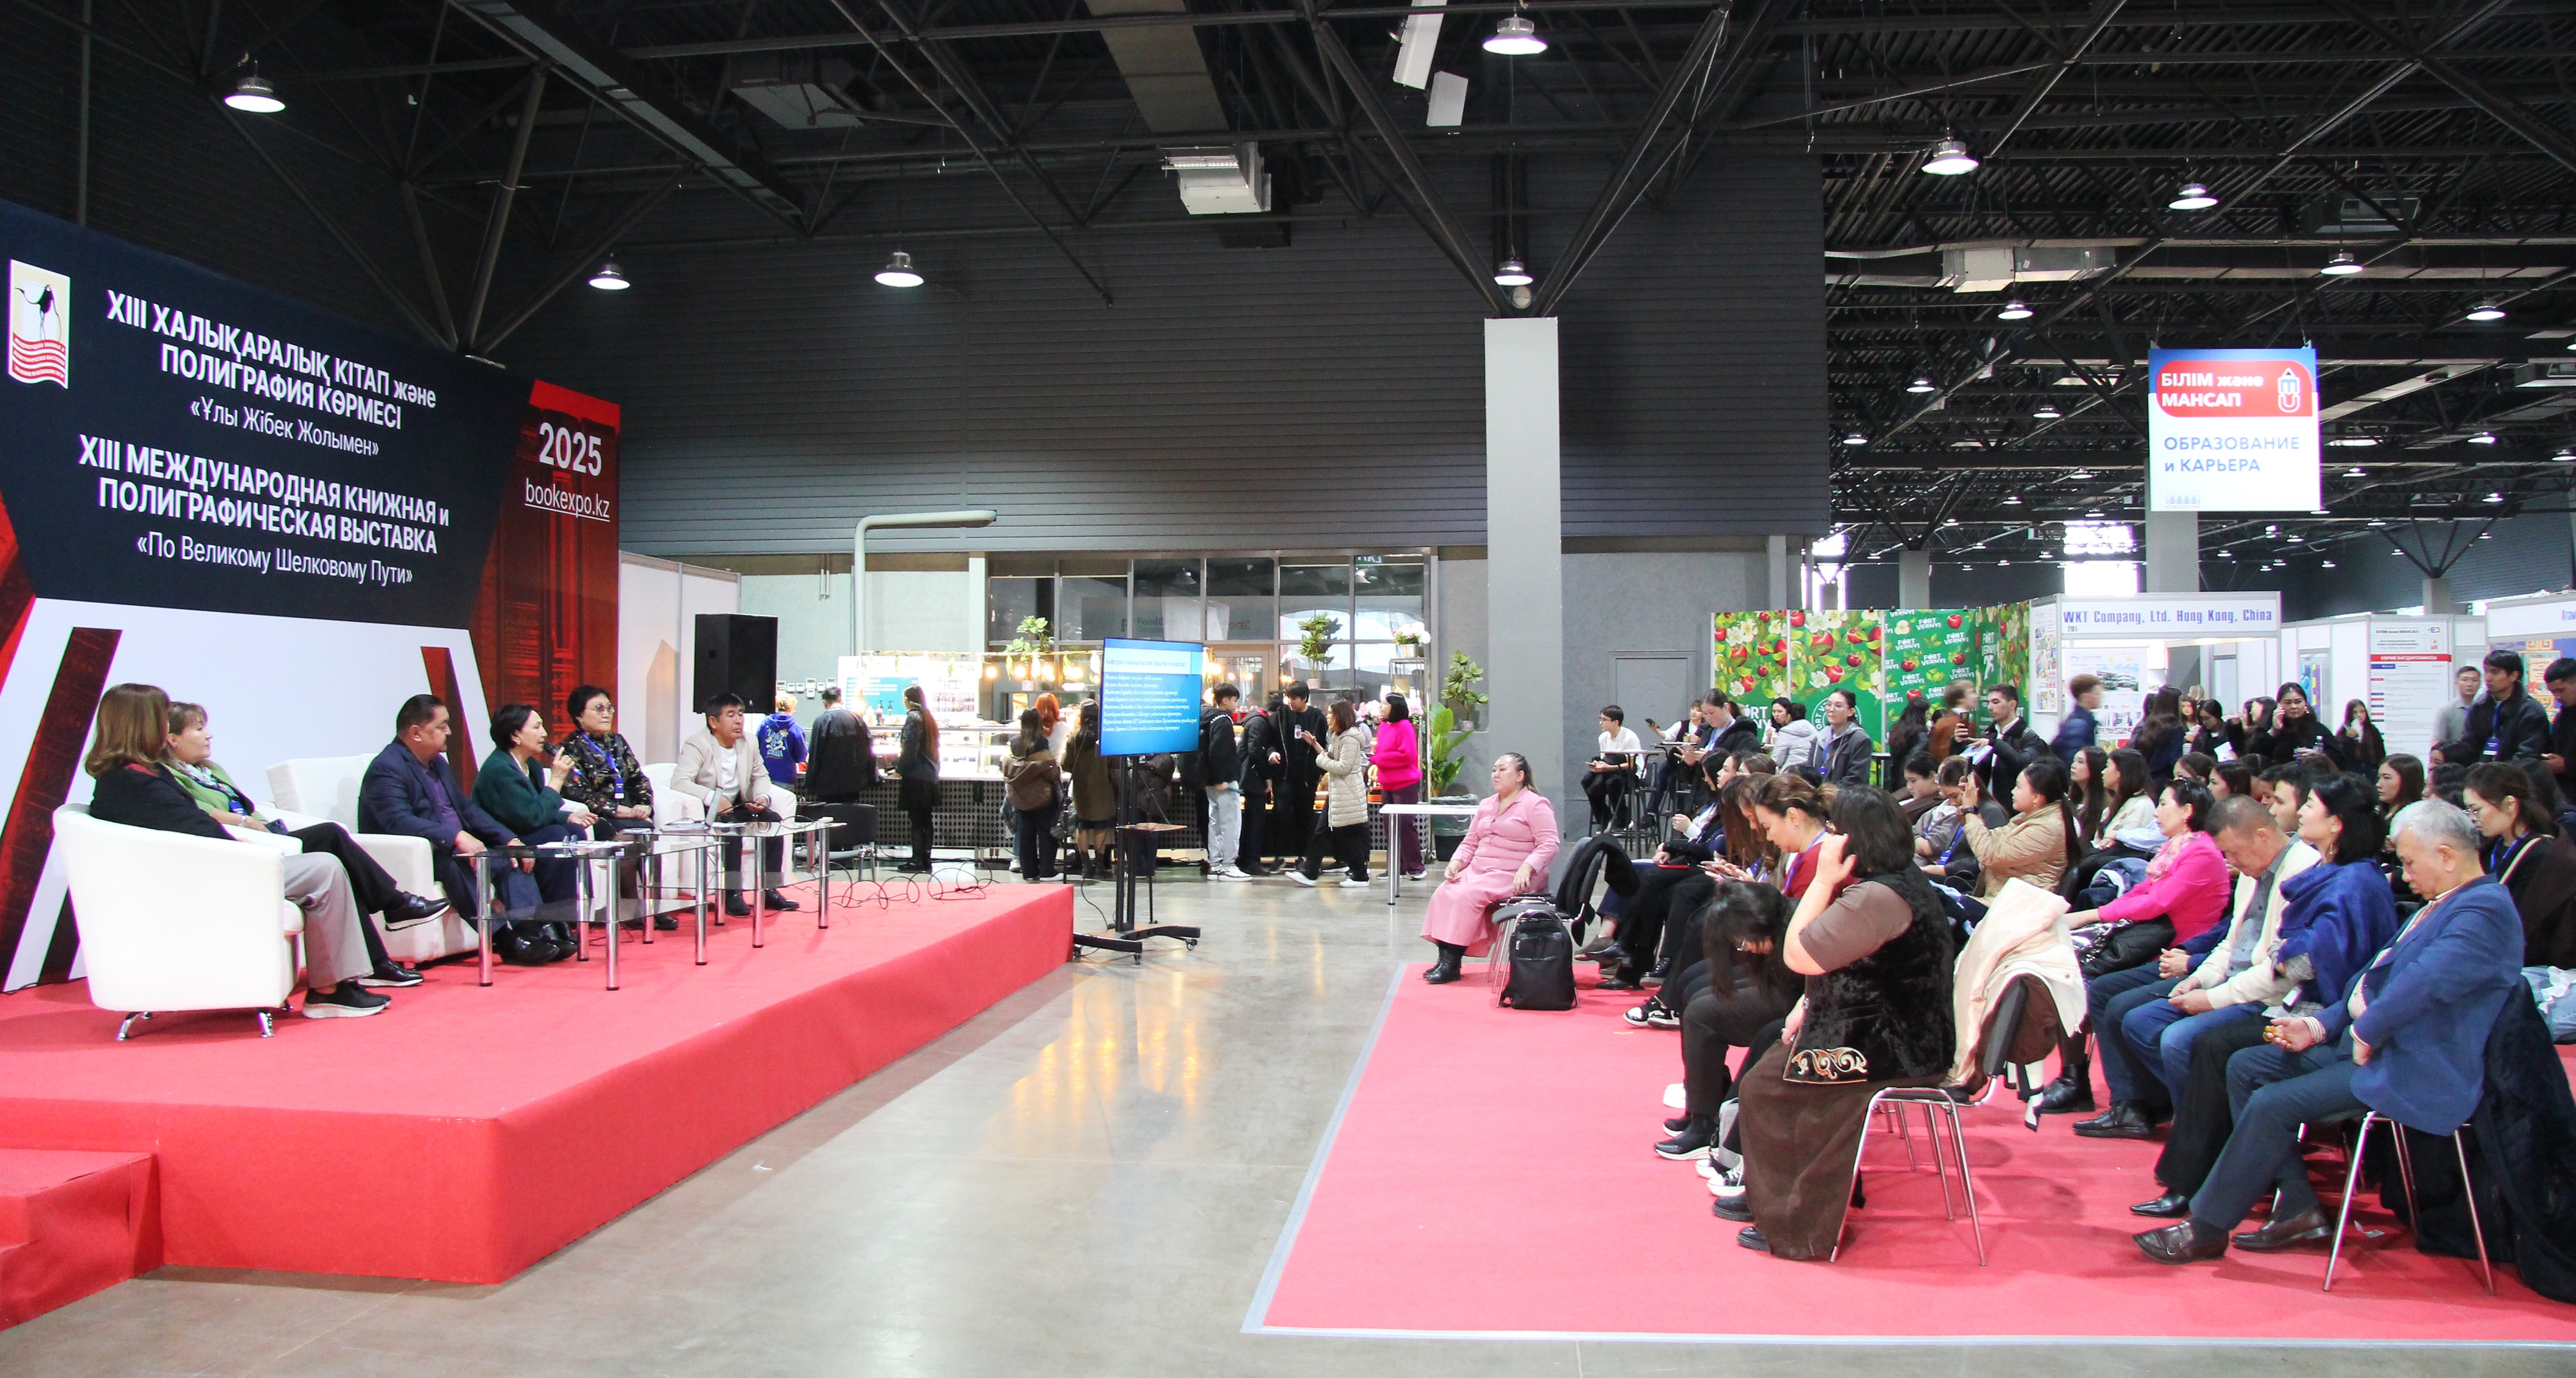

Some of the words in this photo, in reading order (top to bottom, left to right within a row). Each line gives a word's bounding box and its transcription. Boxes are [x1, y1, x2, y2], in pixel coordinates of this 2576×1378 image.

[152, 303, 330, 386] ХАЛЫҚАРАЛЫҚ
[334, 357, 390, 396] КІТАП
[393, 380, 436, 408] және
[2162, 373, 2213, 387] БІЛІМ
[2217, 376, 2264, 387] және
[161, 343, 314, 408] ПОЛИГРАФИЯ
[318, 384, 402, 429] КӨРМЕСІ
[2162, 392, 2242, 407] МАНСАП
[190, 396, 238, 427] «Ұлы
[243, 406, 293, 439] Жібек
[297, 419, 379, 456] Жолымен»
[539, 422, 602, 476] 2025
[2164, 437, 2299, 450] ОБРАЗОВАНИЕ
[126, 443, 341, 508] МЕЖДУНАРОДНАЯ
[344, 485, 436, 524] КНИЖНАЯ
[439, 508, 449, 527] и
[2165, 462, 2174, 471] и
[2180, 459, 2260, 471] КАРЬЕРА
[98, 476, 336, 540] ПОЛИГРАФИЧЕСКАЯ
[339, 516, 437, 554] ВЫСТАВКА
[526, 477, 610, 519] bookexpo.kz
[137, 531, 175, 558] «По
[180, 535, 271, 574] Великому
[275, 547, 367, 585] Шелковому
[370, 559, 413, 587] Пути»
[2063, 611, 2088, 622] WKT
[2094, 611, 2145, 624] Company,
[2150, 610, 2171, 622] Ltd.
[2176, 610, 2202, 624] Hong
[2208, 610, 2238, 623] Kong,
[2243, 609, 2272, 621] China
